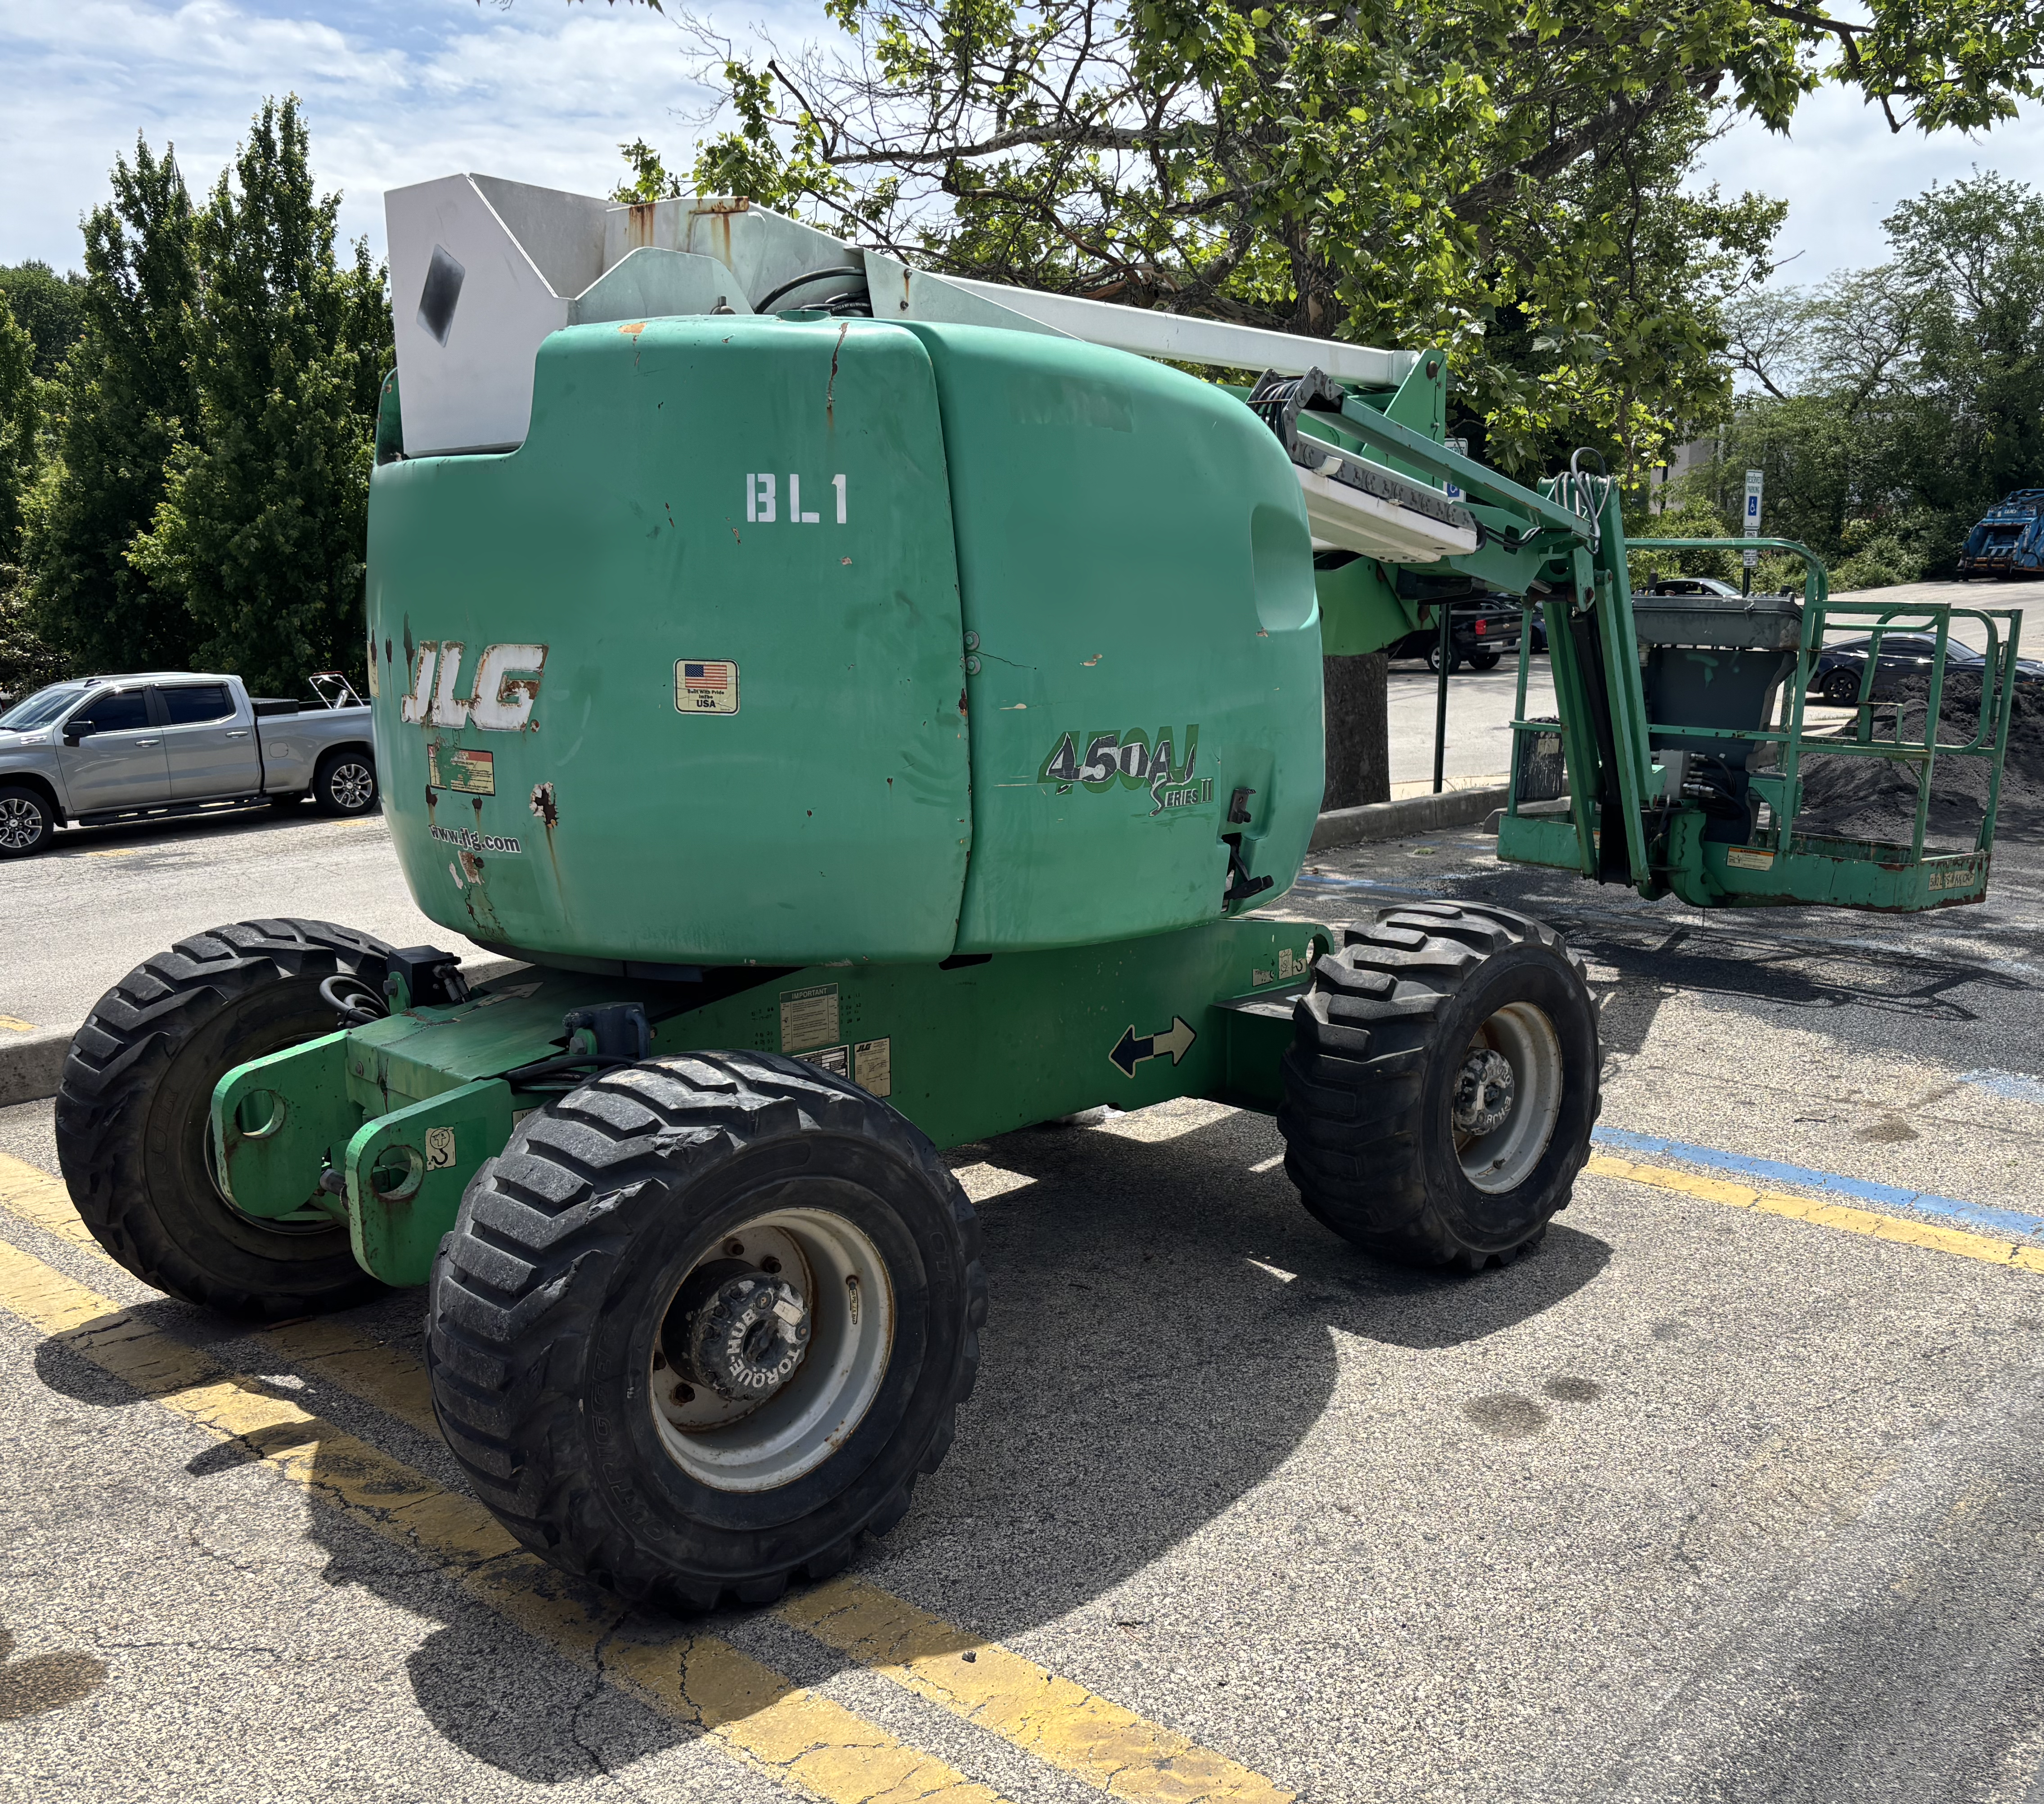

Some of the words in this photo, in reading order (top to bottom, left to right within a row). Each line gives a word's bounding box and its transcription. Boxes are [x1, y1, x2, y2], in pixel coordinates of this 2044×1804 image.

[746, 473, 847, 524] BL1
[401, 641, 549, 731] JLG
[696, 700, 716, 708] USA
[428, 824, 522, 853] www.jlg.com
[792, 987, 827, 1000] IMPORTANT
[856, 1043, 872, 1053] JLG
